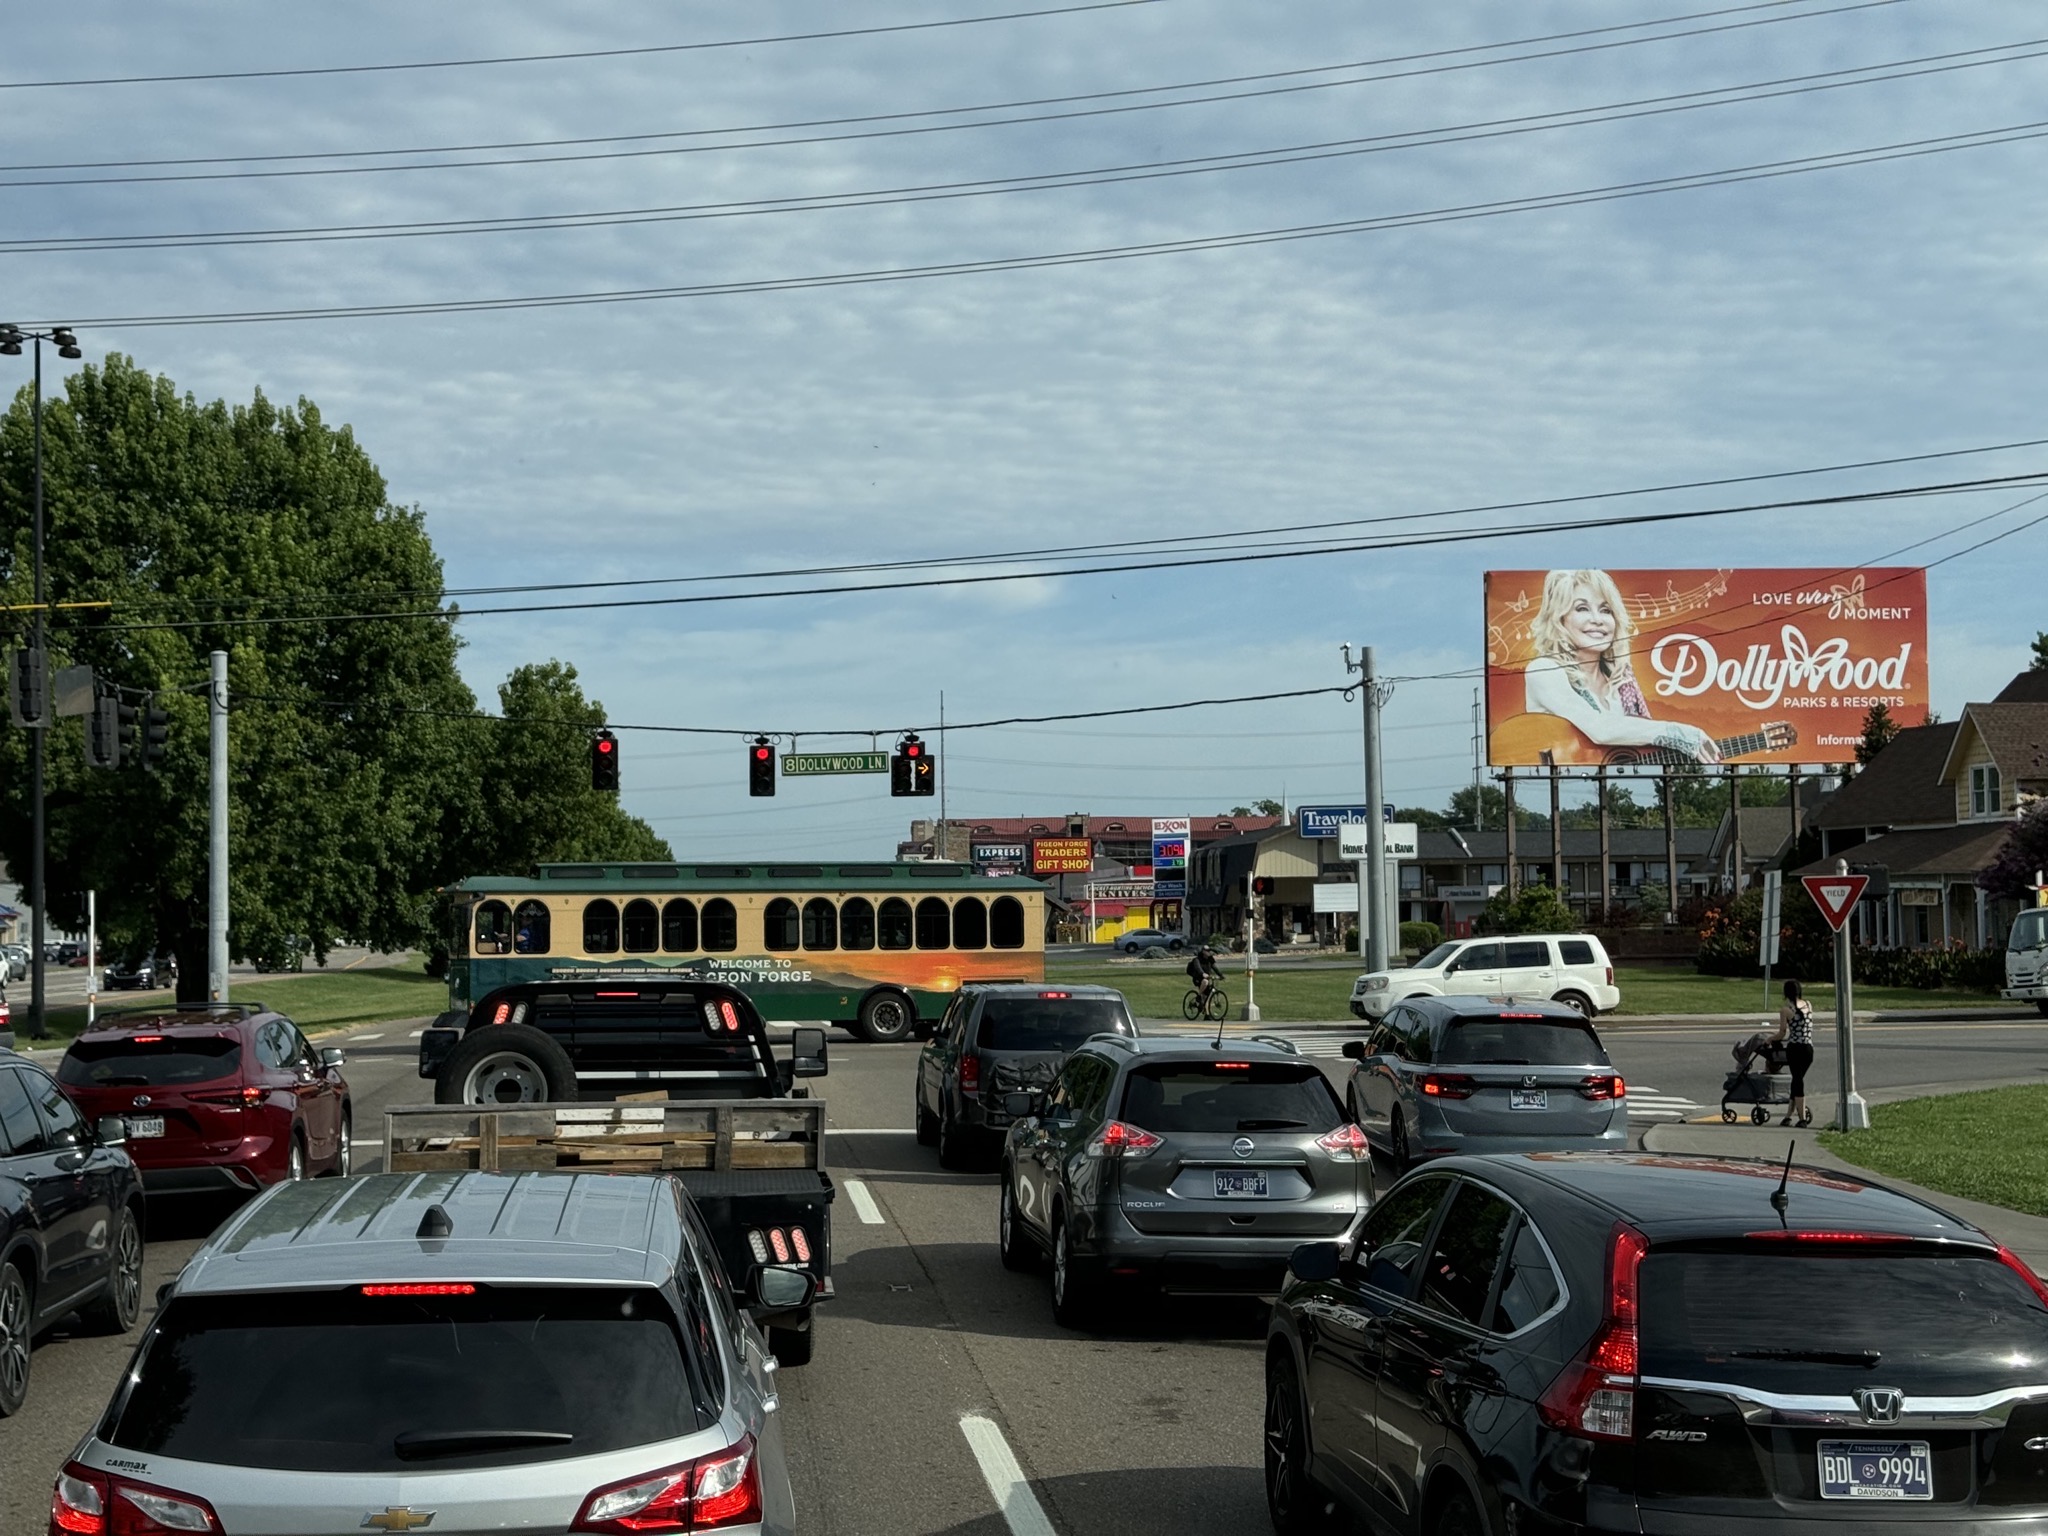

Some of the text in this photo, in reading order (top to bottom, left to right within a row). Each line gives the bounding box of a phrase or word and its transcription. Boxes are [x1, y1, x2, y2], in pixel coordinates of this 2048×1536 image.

[1753, 590, 1843, 620] LOVE every
[1844, 608, 1911, 620] MOMENT
[1784, 696, 1904, 708] PARKS & RESORTS
[786, 756, 885, 771] 8 DOLLYWOOD LN.
[1304, 810, 1389, 826] Traveloe
[1154, 820, 1187, 833] EXXON
[980, 848, 1020, 857] EXPRESS
[1038, 848, 1087, 857] TRADERS
[1342, 844, 1363, 854] HOME
[1394, 844, 1414, 854] BANK
[1036, 859, 1089, 869] GIFT SHOP
[1098, 889, 1148, 897] KNIVES
[1826, 889, 1846, 897] YIELD
[709, 960, 792, 969] WELCOME TO
[707, 971, 812, 982] GEON FORGE
[1217, 1177, 1266, 1191] 912 BBFP
[1645, 1430, 1708, 1441] AWD
[1823, 1456, 1926, 1485] BDL 9994
[1857, 1488, 1899, 1497] DAVIDSON
